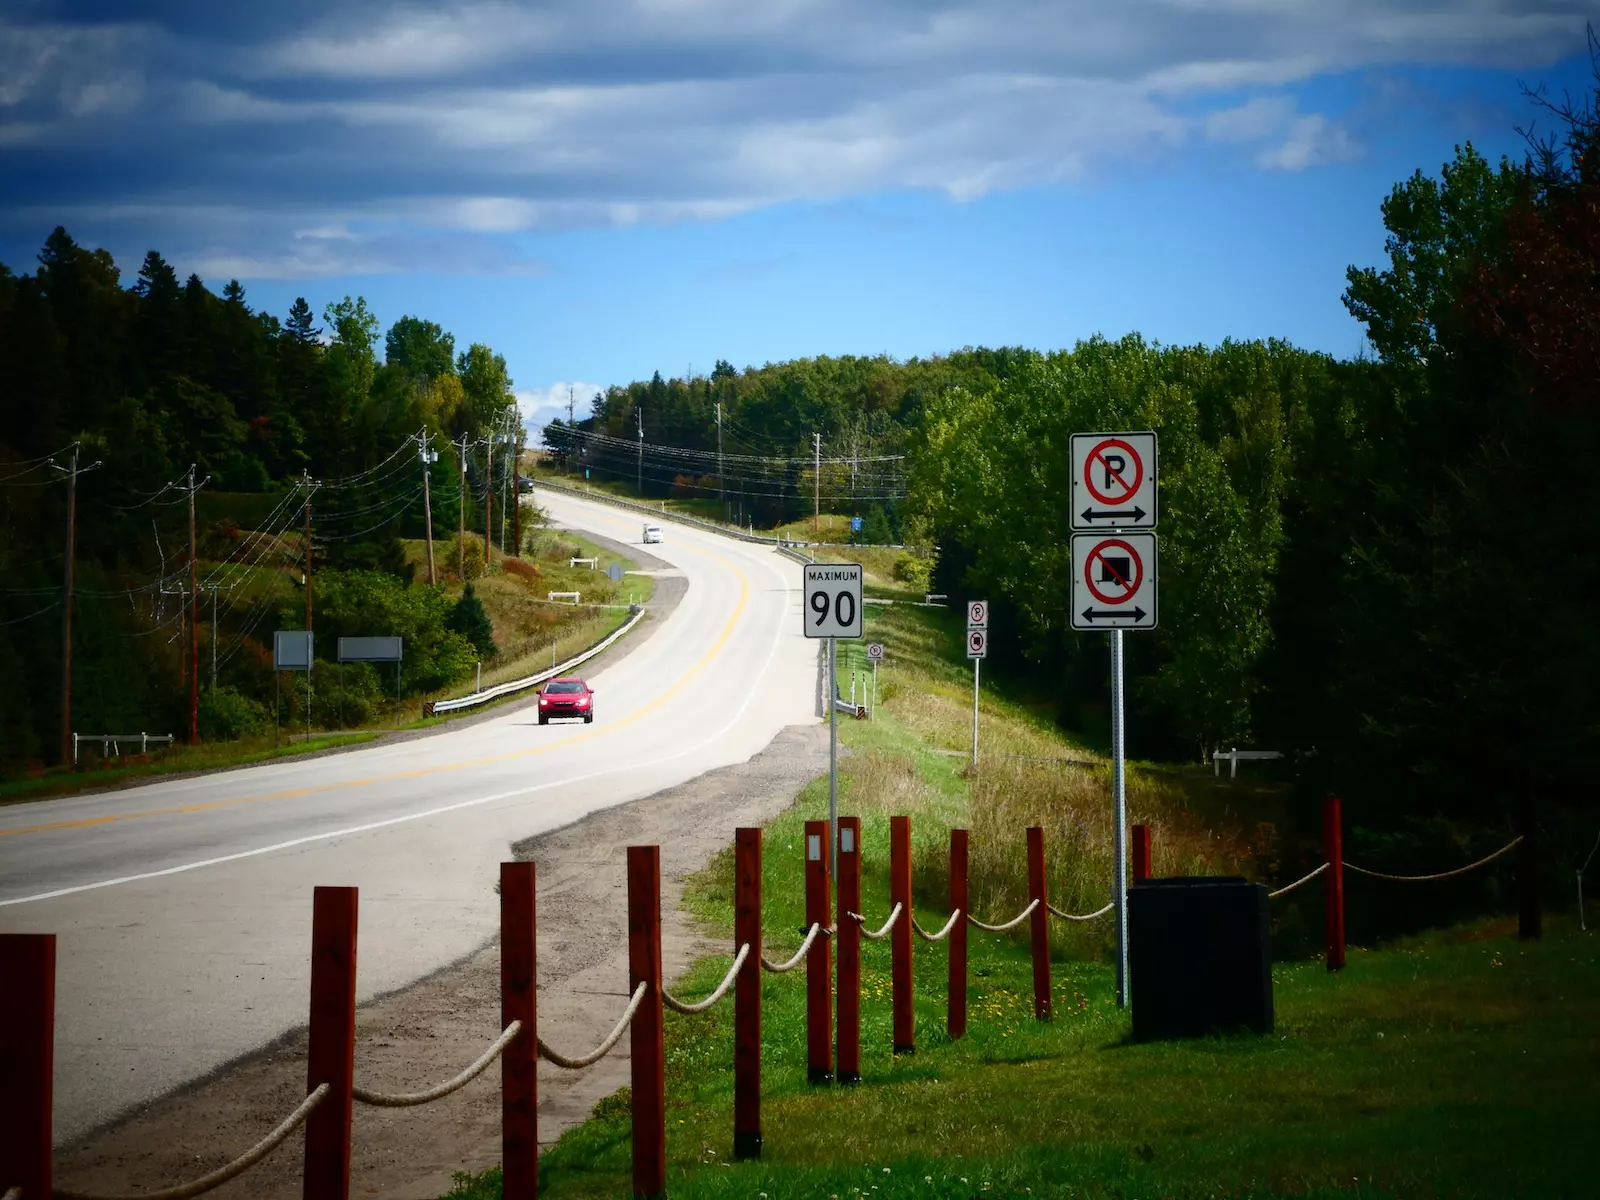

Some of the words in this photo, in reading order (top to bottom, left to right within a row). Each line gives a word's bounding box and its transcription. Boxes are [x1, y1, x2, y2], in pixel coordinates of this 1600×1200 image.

[1105, 455, 1126, 489] P
[808, 571, 858, 581] MAXIMUM
[810, 590, 856, 628] 90
